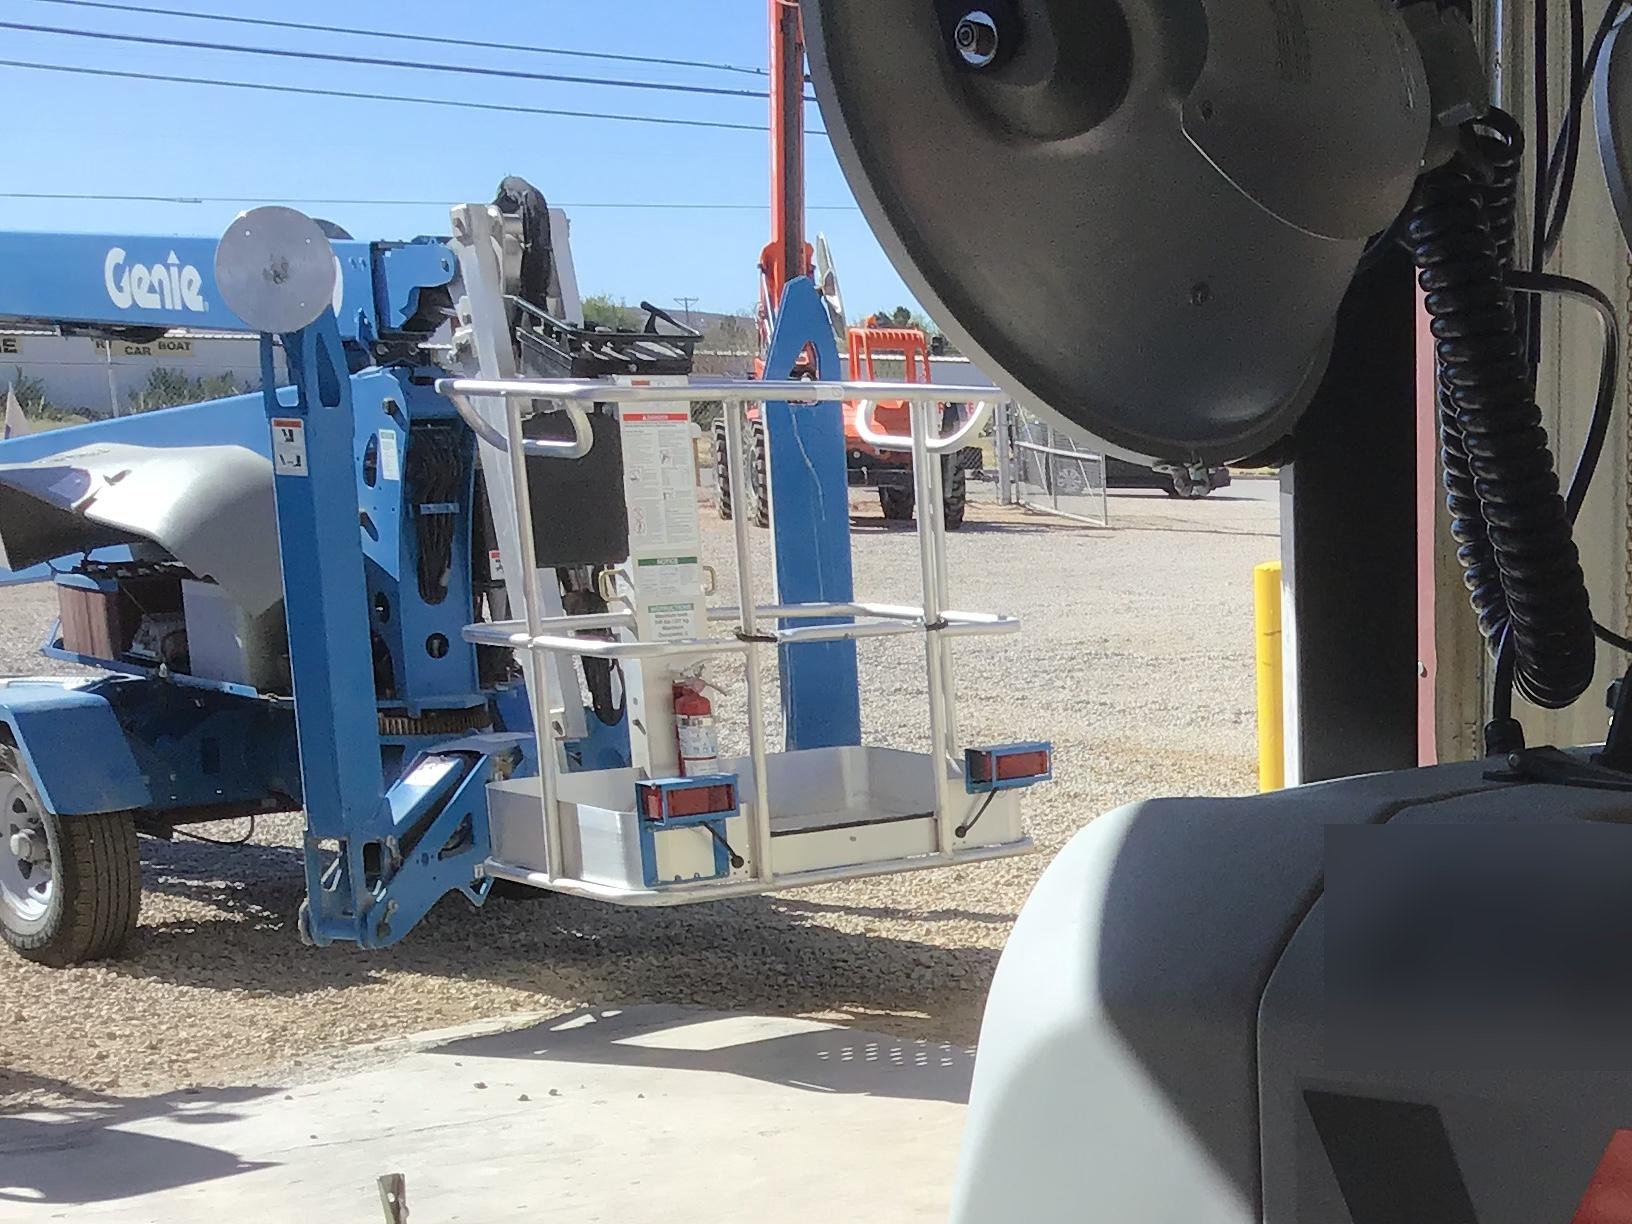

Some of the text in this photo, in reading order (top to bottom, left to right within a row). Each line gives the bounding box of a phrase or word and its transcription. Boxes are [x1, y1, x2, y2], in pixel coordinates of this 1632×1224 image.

[104, 247, 205, 312] Genie
[125, 346, 151, 356] CAR
[158, 341, 191, 351] BOAT
